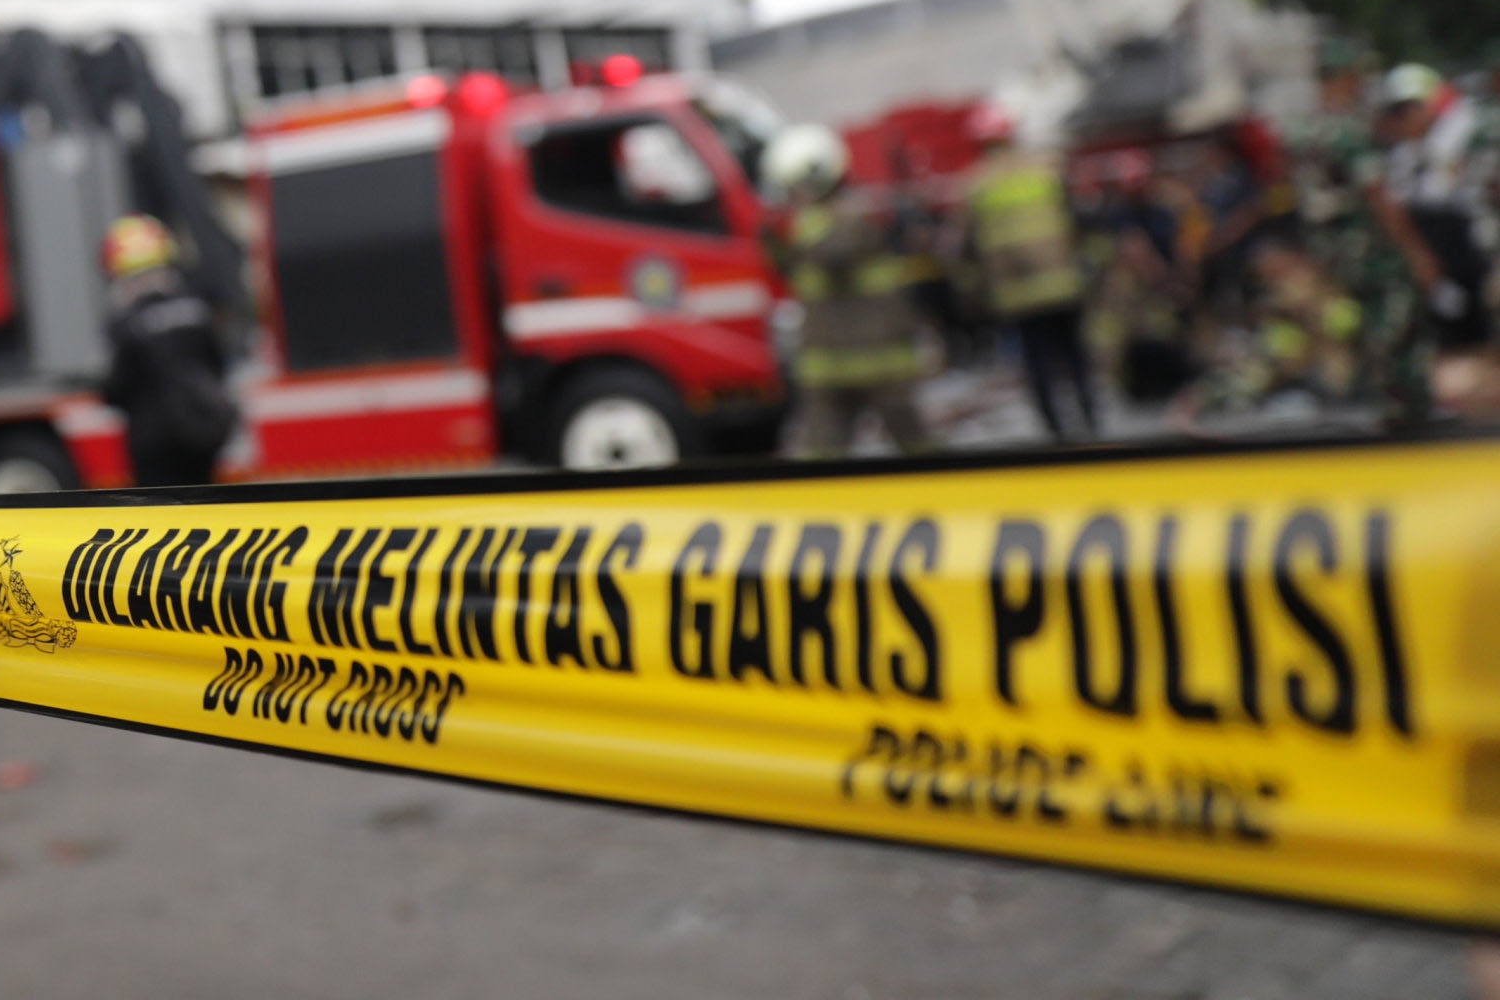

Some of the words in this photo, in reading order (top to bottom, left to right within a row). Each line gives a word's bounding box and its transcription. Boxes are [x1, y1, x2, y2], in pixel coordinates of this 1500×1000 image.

[61, 525, 309, 642] DILARANG
[307, 522, 643, 673] MELINTAS
[669, 516, 943, 702] GARIS
[989, 508, 1414, 738] POLISI
[203, 646, 264, 716] DO
[253, 651, 337, 725] NOT
[326, 660, 466, 745] CROSS
